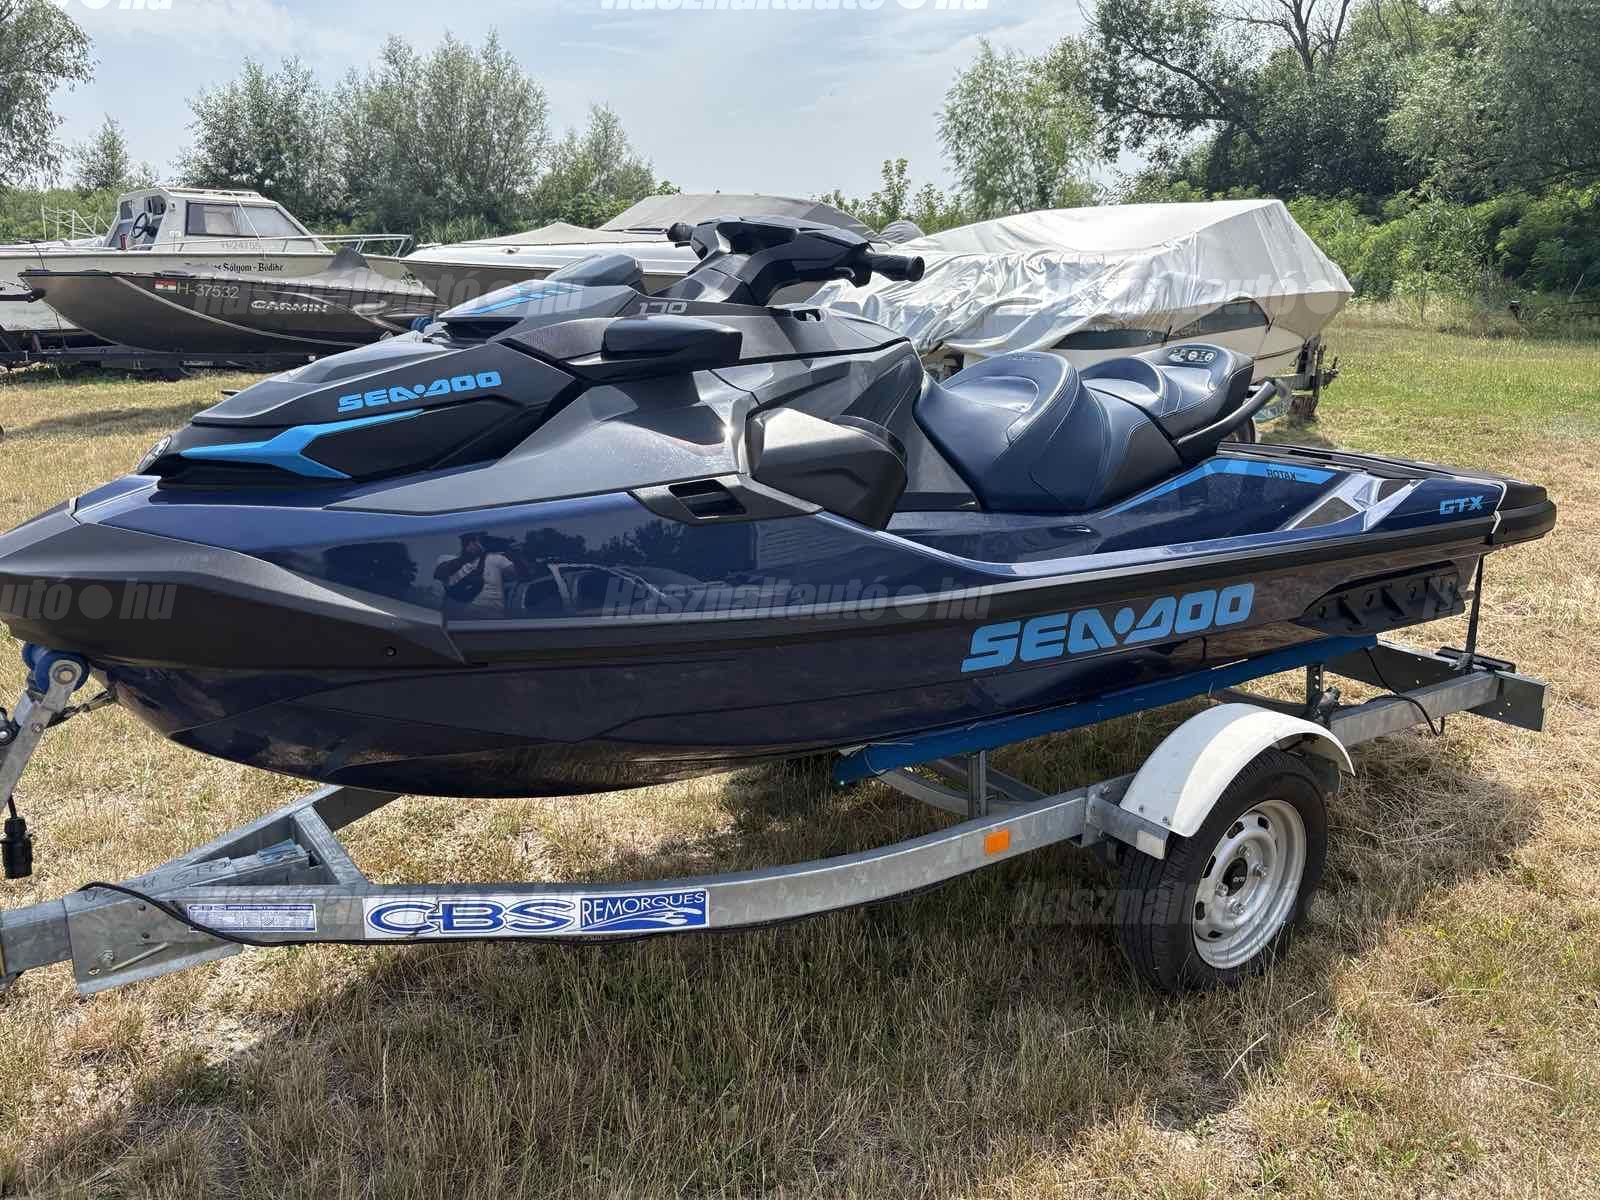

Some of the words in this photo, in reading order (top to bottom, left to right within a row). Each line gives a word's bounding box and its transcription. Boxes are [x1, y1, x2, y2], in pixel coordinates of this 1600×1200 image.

[177, 283, 240, 298] H-37532
[251, 300, 329, 313] GARMIN
[640, 302, 688, 313] 170
[365, 899, 576, 934] CBS
[582, 892, 705, 924] REMORQUES
